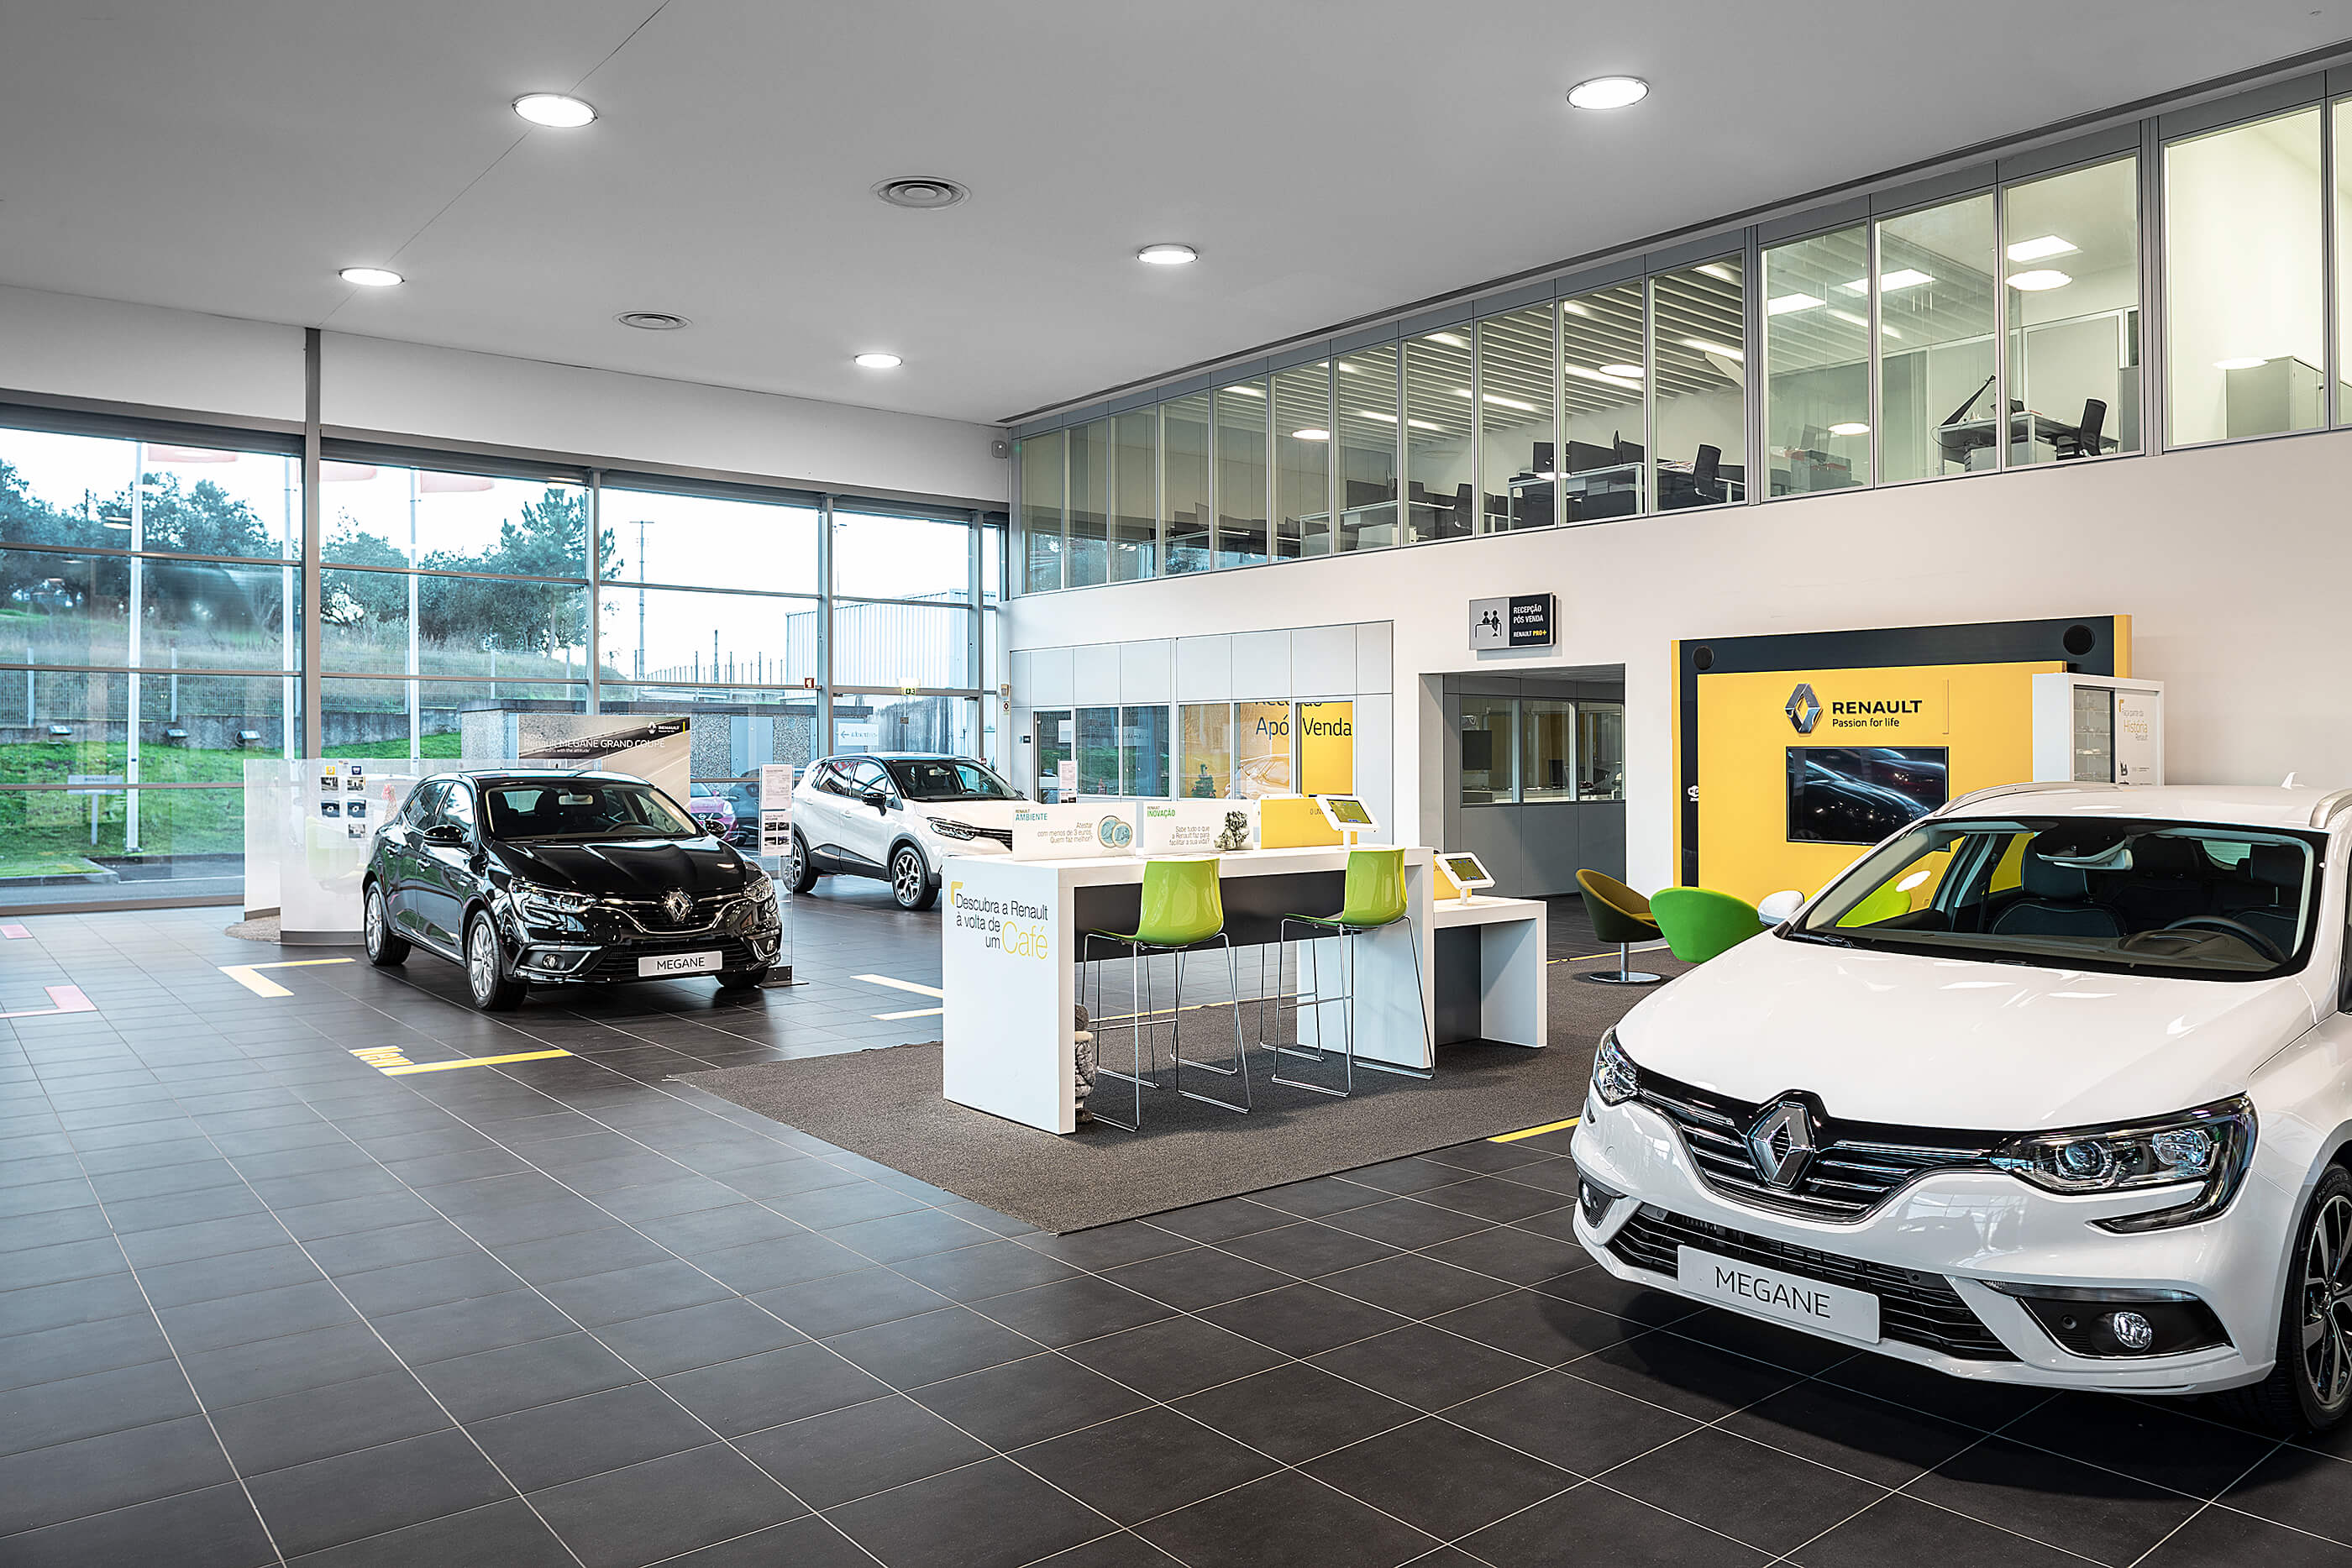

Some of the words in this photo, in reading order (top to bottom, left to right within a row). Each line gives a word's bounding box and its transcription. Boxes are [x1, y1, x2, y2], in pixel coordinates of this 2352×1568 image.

[1513, 604, 1542, 614] RECEPÇÃO
[1513, 615, 1525, 624] PÓS
[1525, 614, 1544, 623] VENDA
[1832, 700, 1923, 715] RENAULT
[1256, 714, 1289, 740] Apó
[1302, 717, 1352, 736] Venda
[1832, 718, 1867, 728] Passion
[1869, 718, 1882, 727] for
[1885, 717, 1900, 727] life
[561, 739, 598, 747] MEGANE
[600, 739, 633, 748] GRAND
[1015, 813, 1047, 821] AMBIENTE
[1147, 809, 1176, 818] INOVAÇÃO
[956, 893, 1000, 914] Descubra
[1002, 903, 1008, 915] a
[1011, 900, 1048, 920] Renault
[956, 911, 962, 927] à
[964, 914, 985, 930] volta
[988, 916, 1000, 932] de
[985, 936, 1000, 949] um
[1002, 920, 1048, 960] Café
[657, 957, 706, 971] MEGANE
[1715, 1266, 1830, 1319] MEGANE
